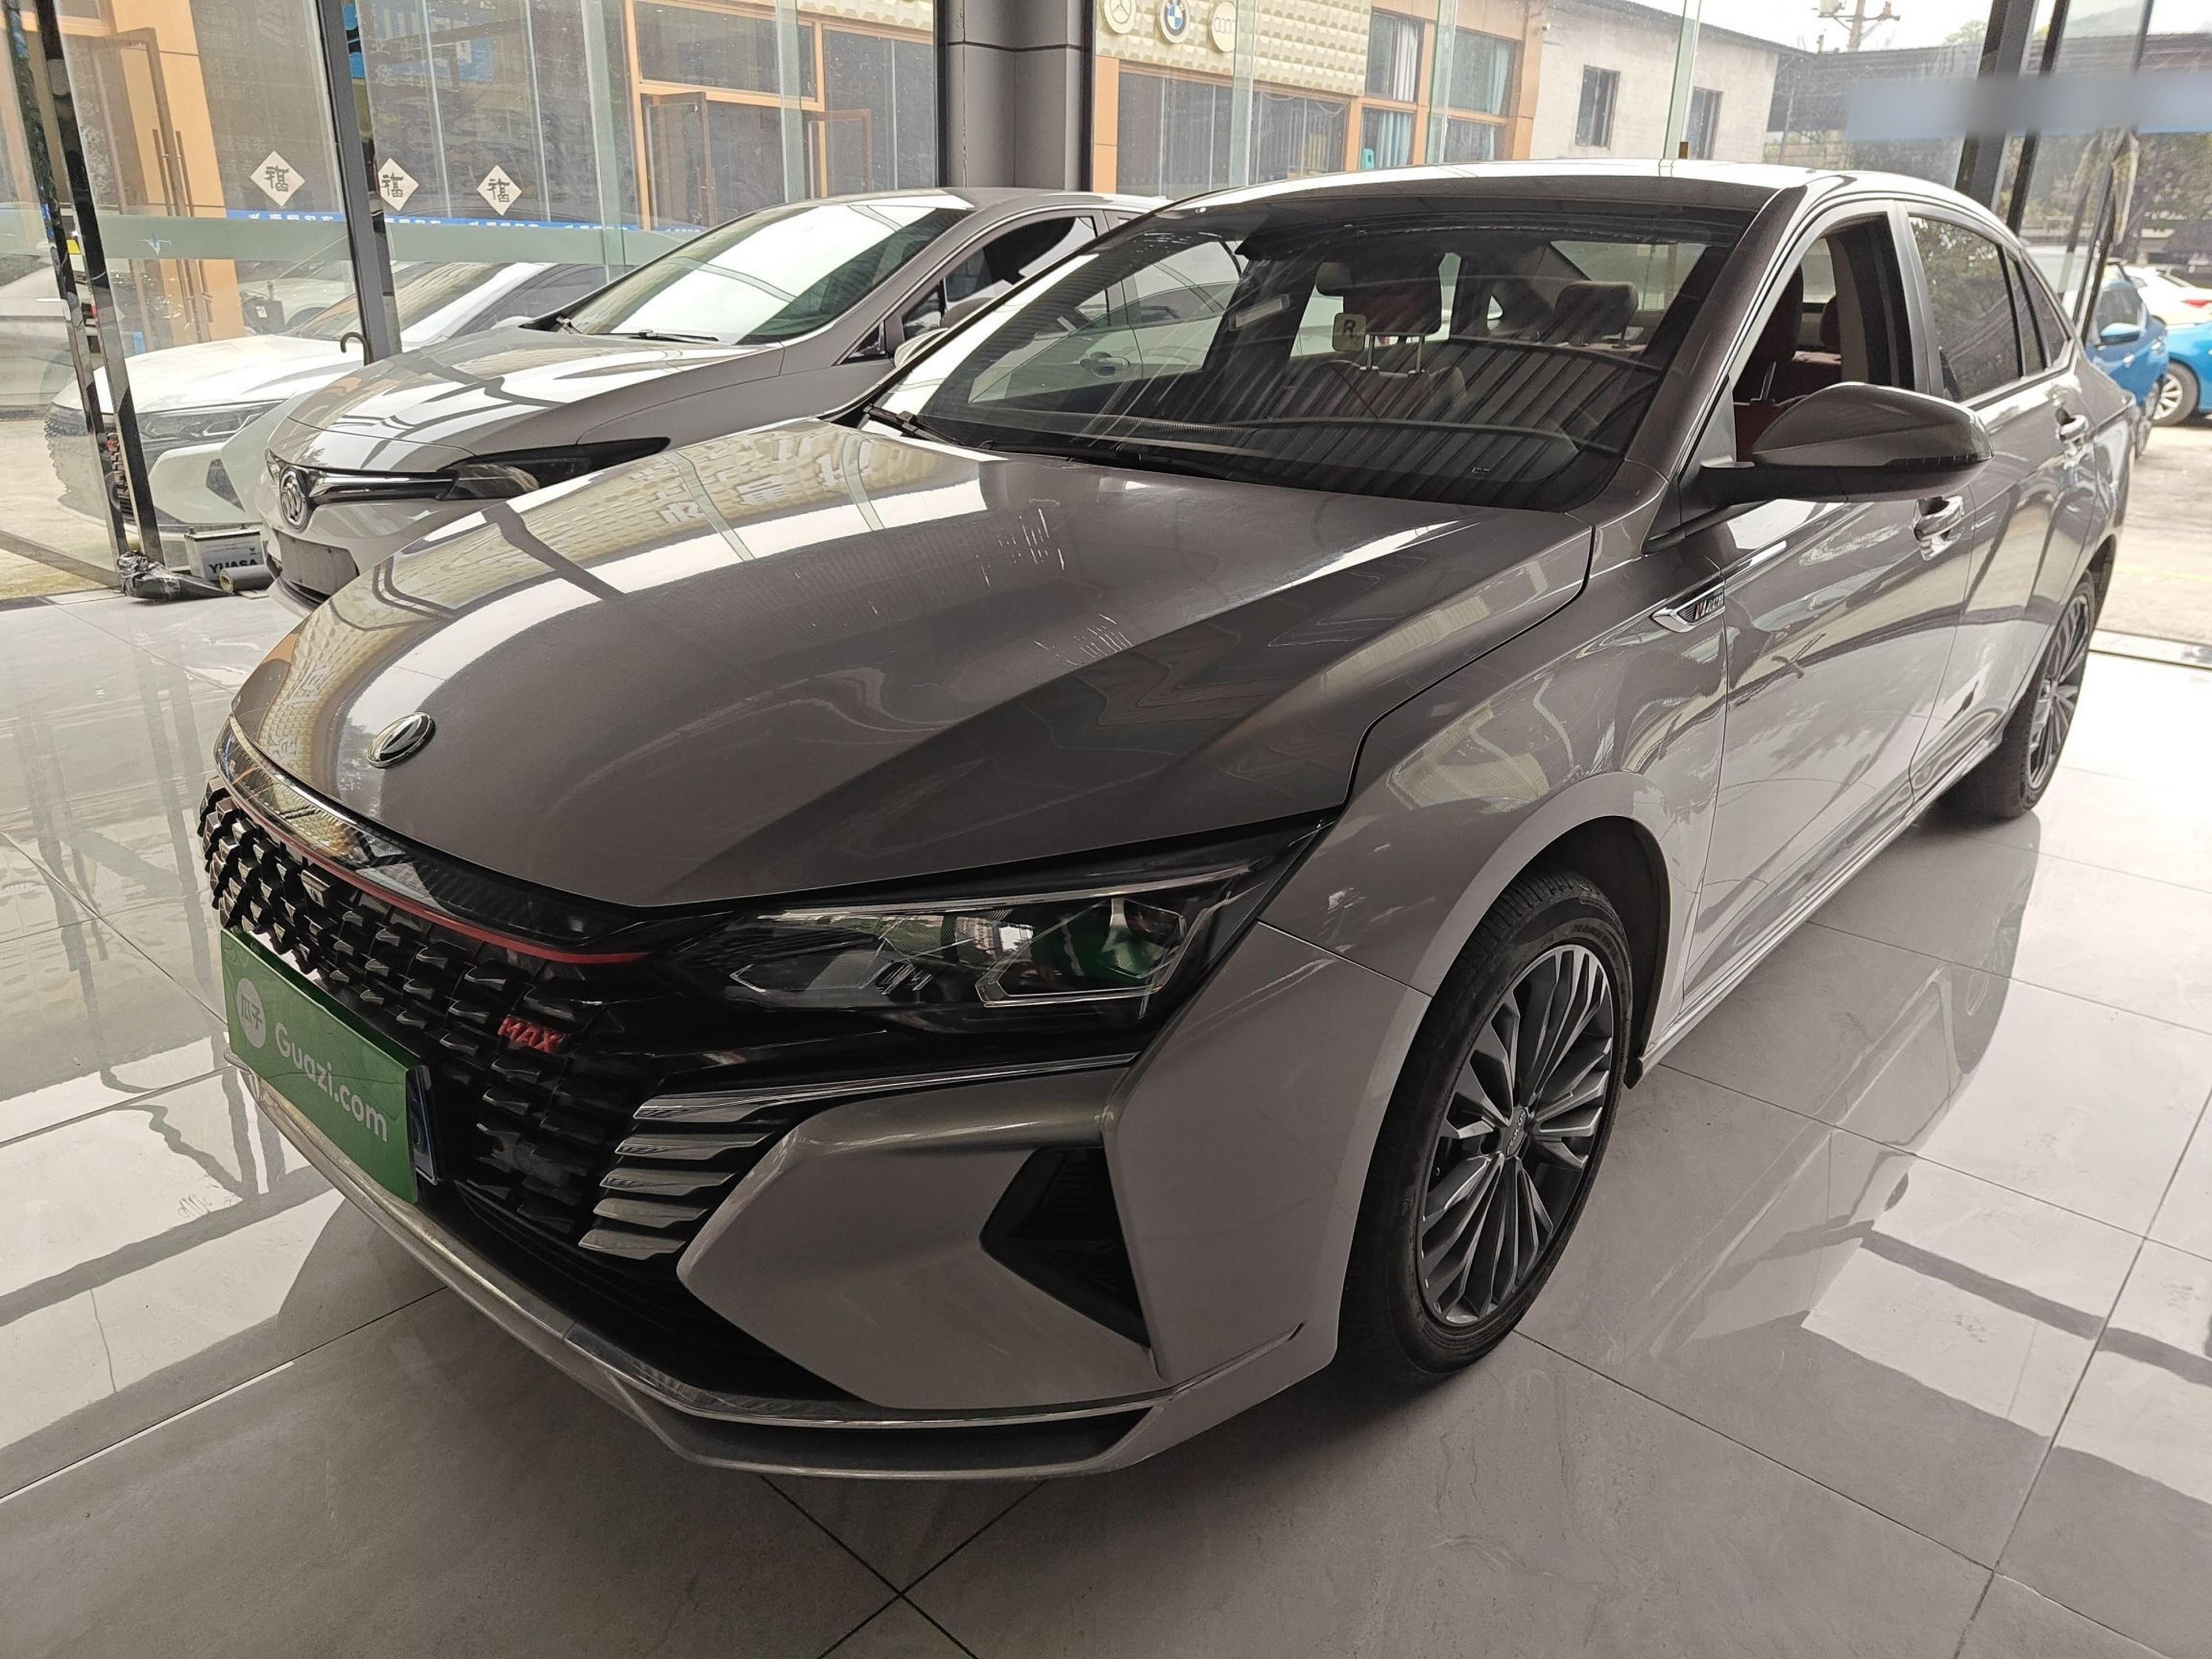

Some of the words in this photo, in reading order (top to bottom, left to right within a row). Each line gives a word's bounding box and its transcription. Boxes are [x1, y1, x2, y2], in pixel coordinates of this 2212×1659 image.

[264, 165, 289, 192] 福
[380, 172, 403, 198] 福
[487, 178, 510, 202] 福
[241, 993, 263, 1031] 瓜子
[497, 1014, 562, 1053] MAX
[275, 1022, 387, 1142] Guazi.com
